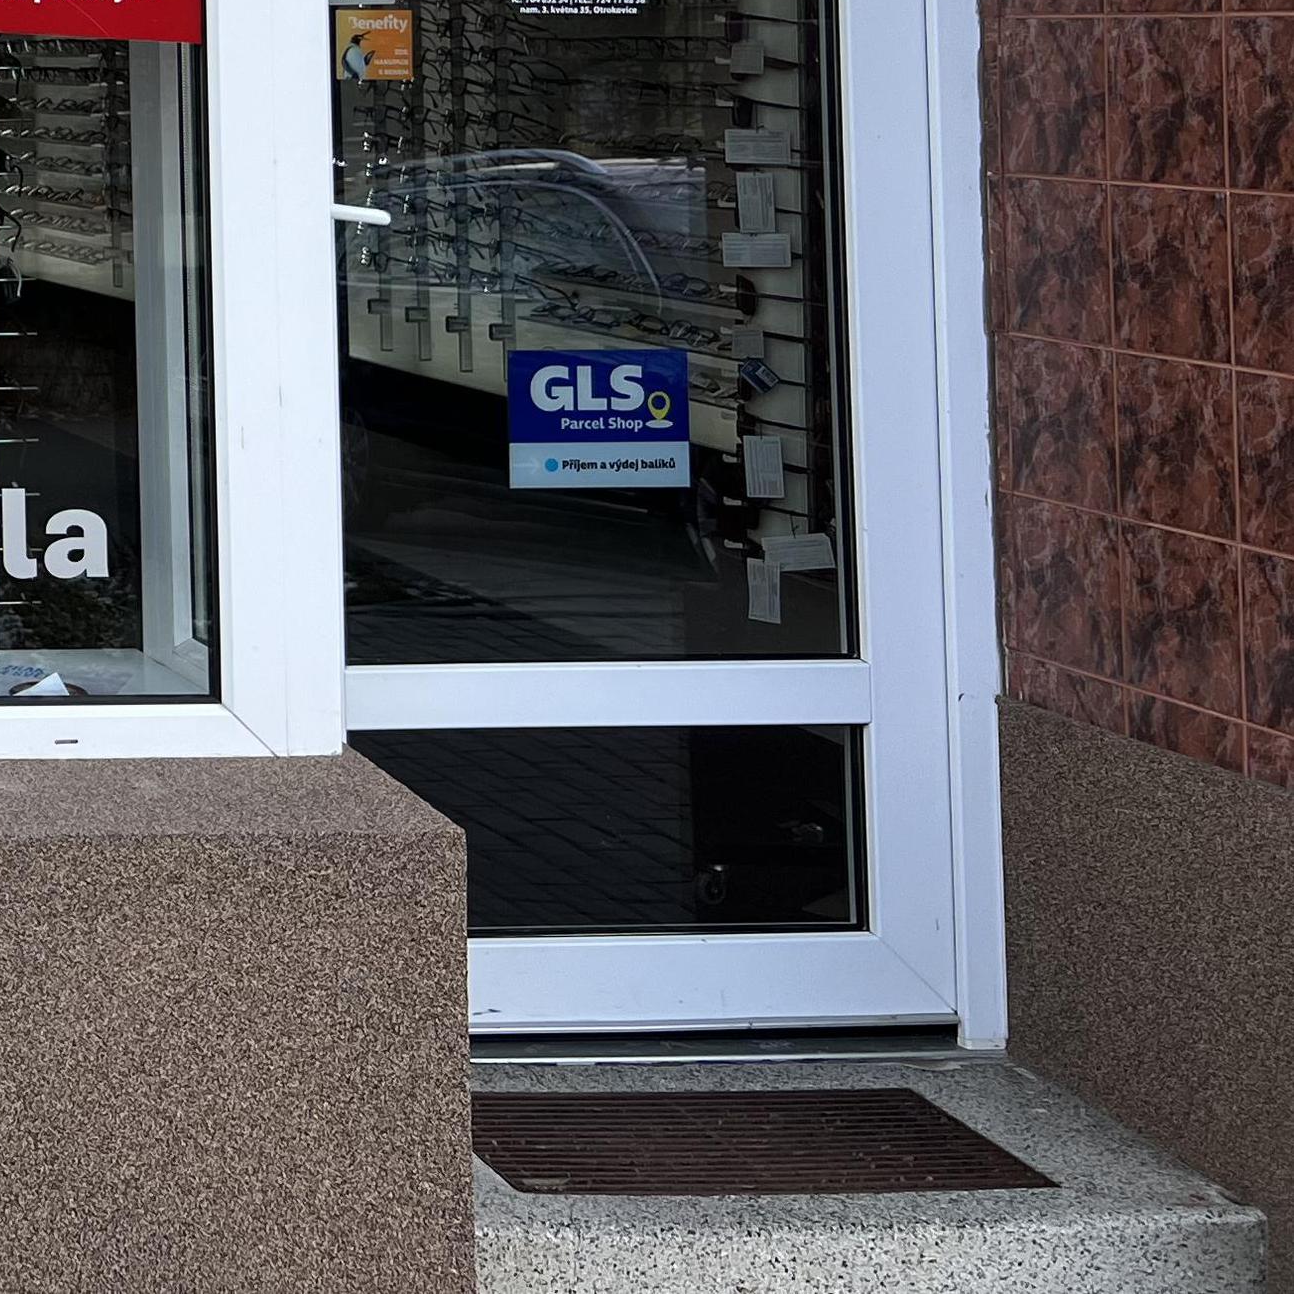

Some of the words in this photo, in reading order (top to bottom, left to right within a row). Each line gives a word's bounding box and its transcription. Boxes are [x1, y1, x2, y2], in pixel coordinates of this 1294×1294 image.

[529, 365, 645, 412] GLS
[560, 417, 605, 430] Parcel
[608, 417, 643, 432] Shop
[562, 458, 598, 472] Příjem
[608, 458, 639, 472] výdej
[641, 458, 676, 470] balíků
